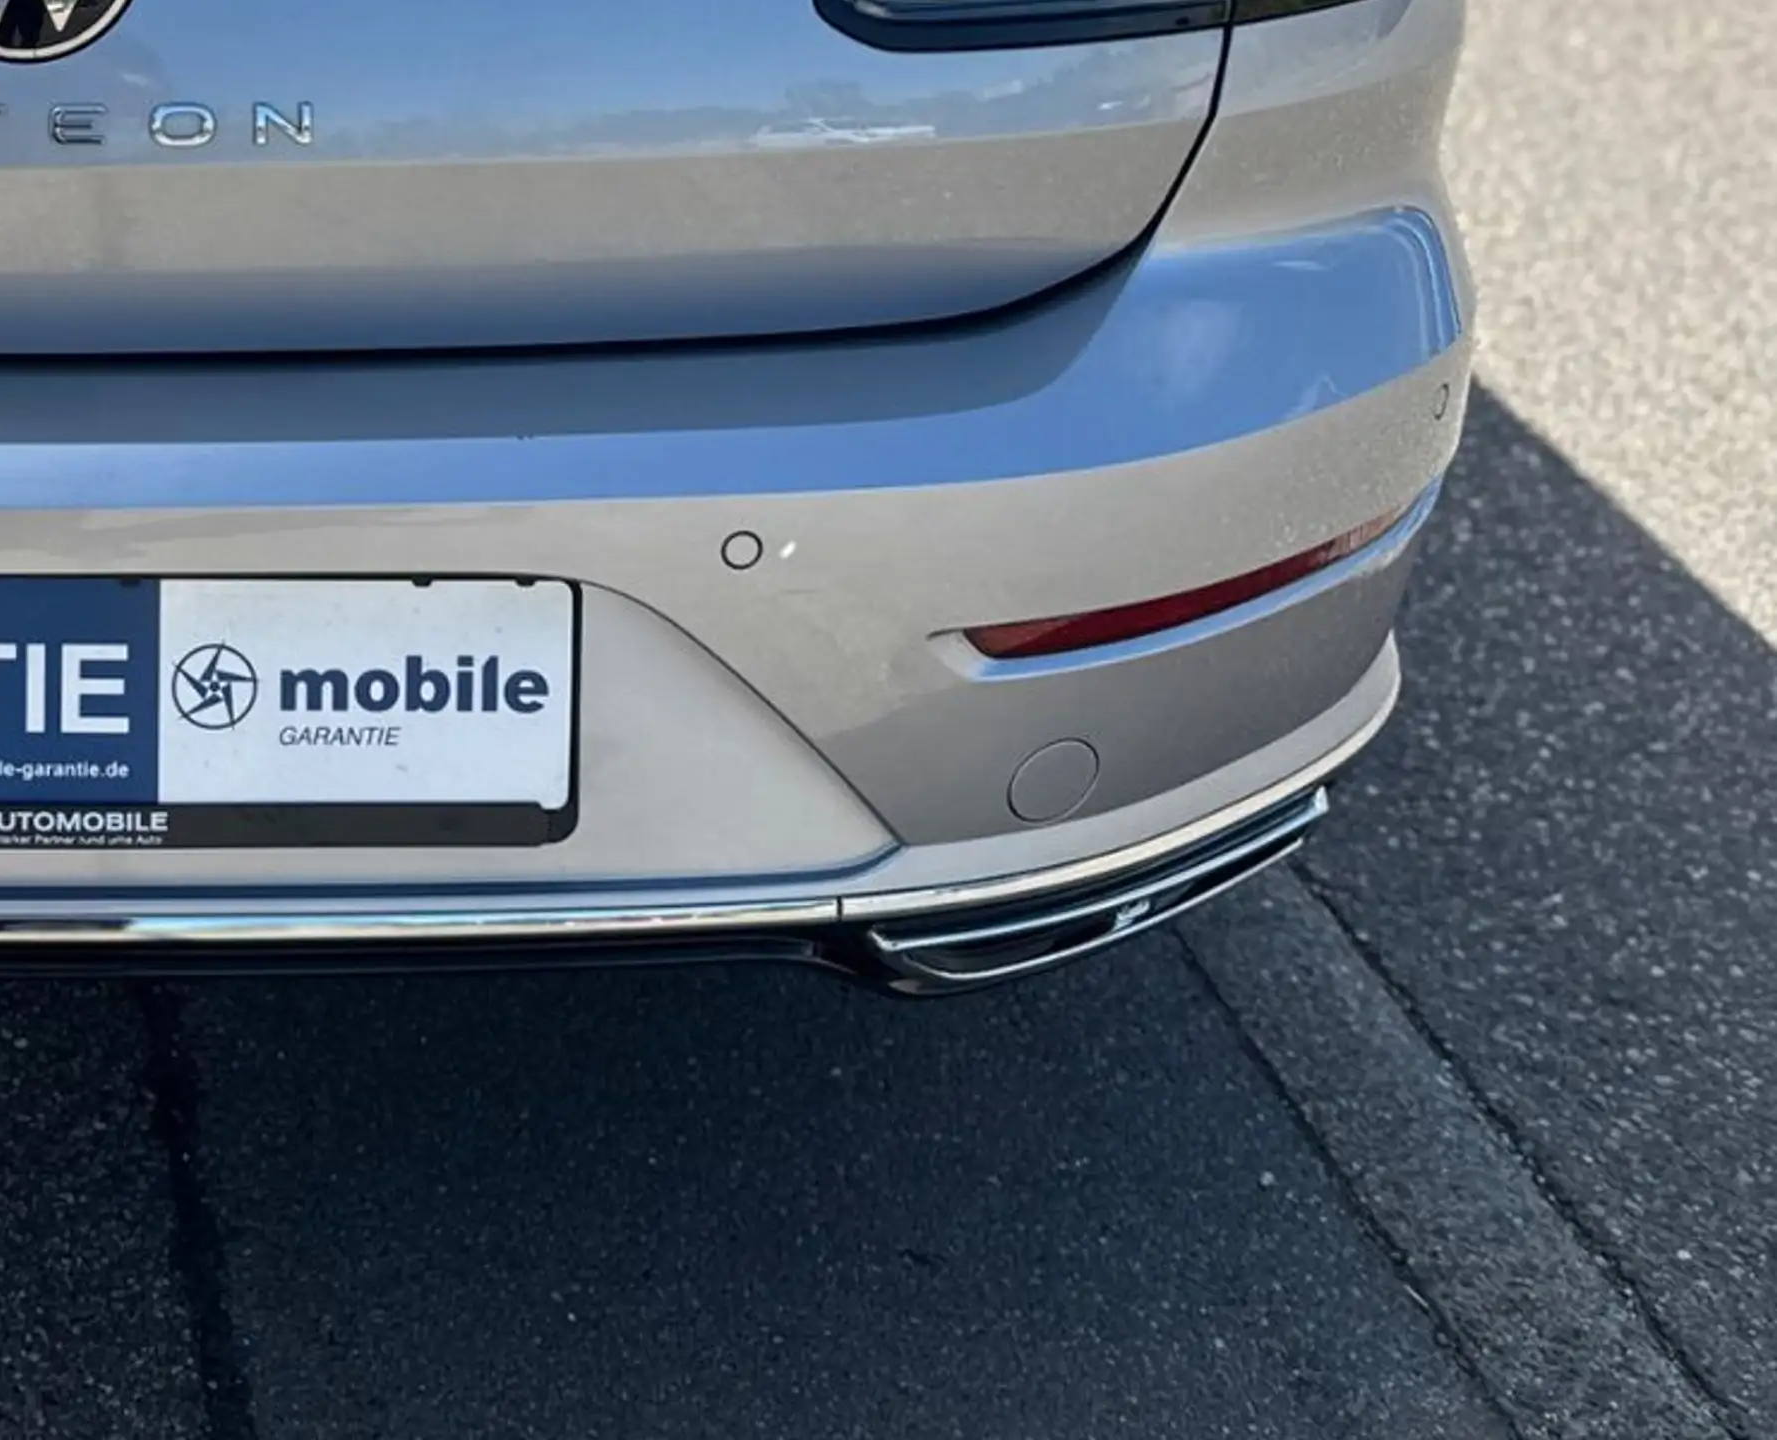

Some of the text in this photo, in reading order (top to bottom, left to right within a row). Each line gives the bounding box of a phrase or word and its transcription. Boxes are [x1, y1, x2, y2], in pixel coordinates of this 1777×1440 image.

[279, 655, 550, 714] mobile
[279, 726, 401, 747] GARANTIE
[34, 834, 75, 845] Partner
[136, 835, 162, 846] Auto
